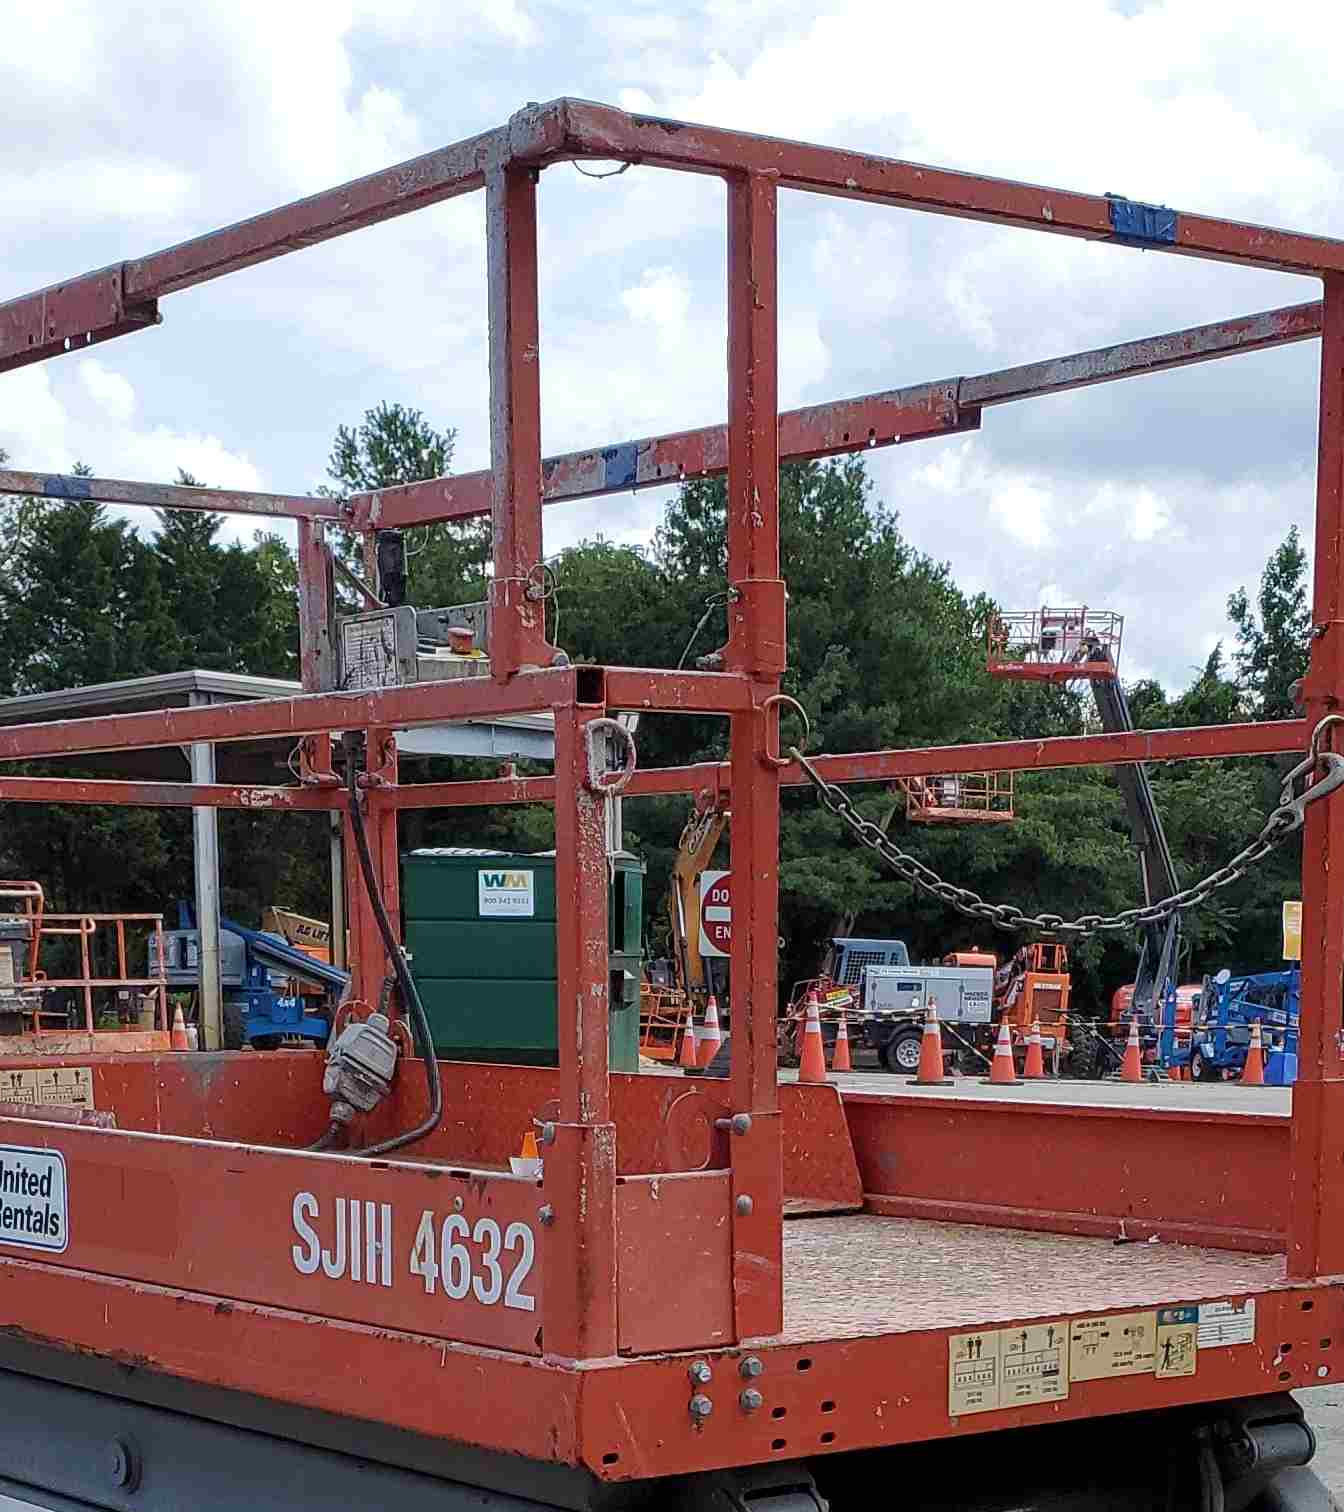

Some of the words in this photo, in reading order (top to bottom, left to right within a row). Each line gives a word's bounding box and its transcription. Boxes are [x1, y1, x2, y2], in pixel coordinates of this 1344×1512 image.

[483, 873, 527, 888] WM
[712, 889, 729, 902] DO
[410, 1210, 535, 1312] 4632
